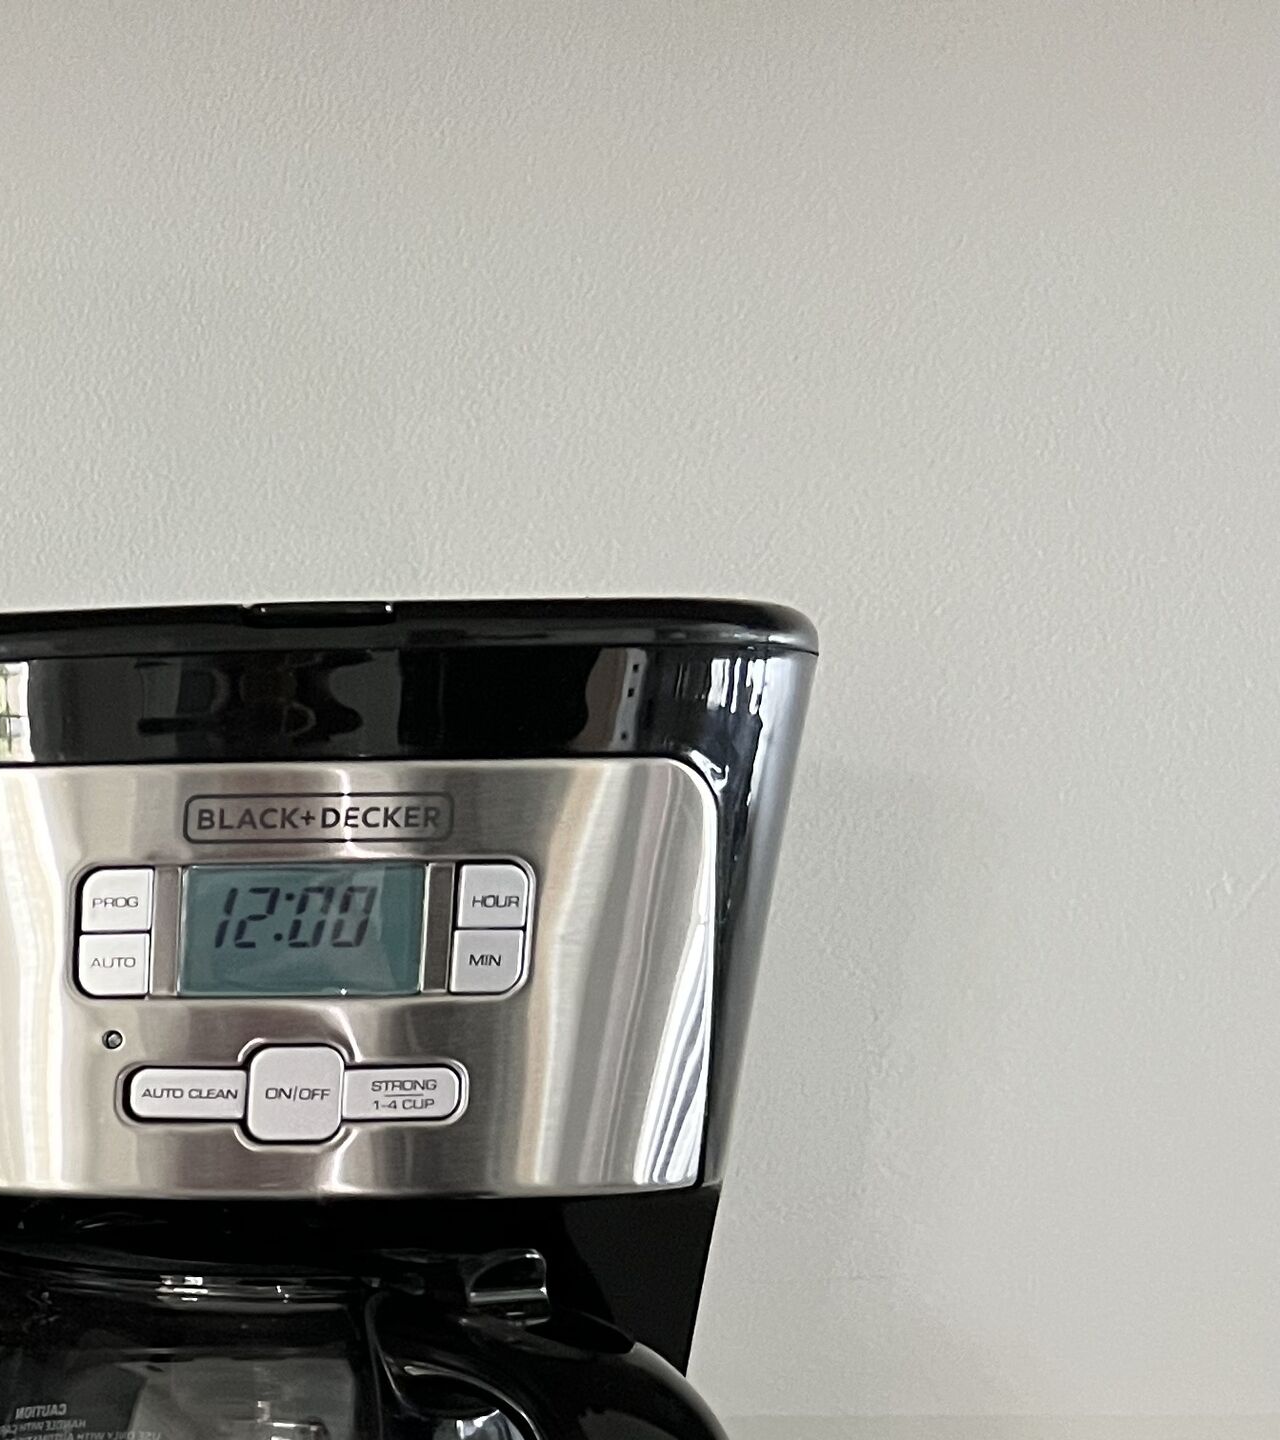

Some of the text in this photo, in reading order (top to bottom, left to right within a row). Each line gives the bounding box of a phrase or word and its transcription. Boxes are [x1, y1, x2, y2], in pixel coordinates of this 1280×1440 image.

[196, 805, 440, 831] BLACK+DECKER
[91, 895, 139, 910] PROG
[471, 894, 521, 909] HOUR
[214, 885, 378, 949] 12:00
[90, 955, 137, 969] AUTO
[468, 953, 502, 968] MIN
[370, 1078, 438, 1093] STRONG
[141, 1086, 239, 1101] AUTO CLEAN
[264, 1085, 332, 1103] ON/OFF
[372, 1098, 436, 1112] 1-4 CUP
